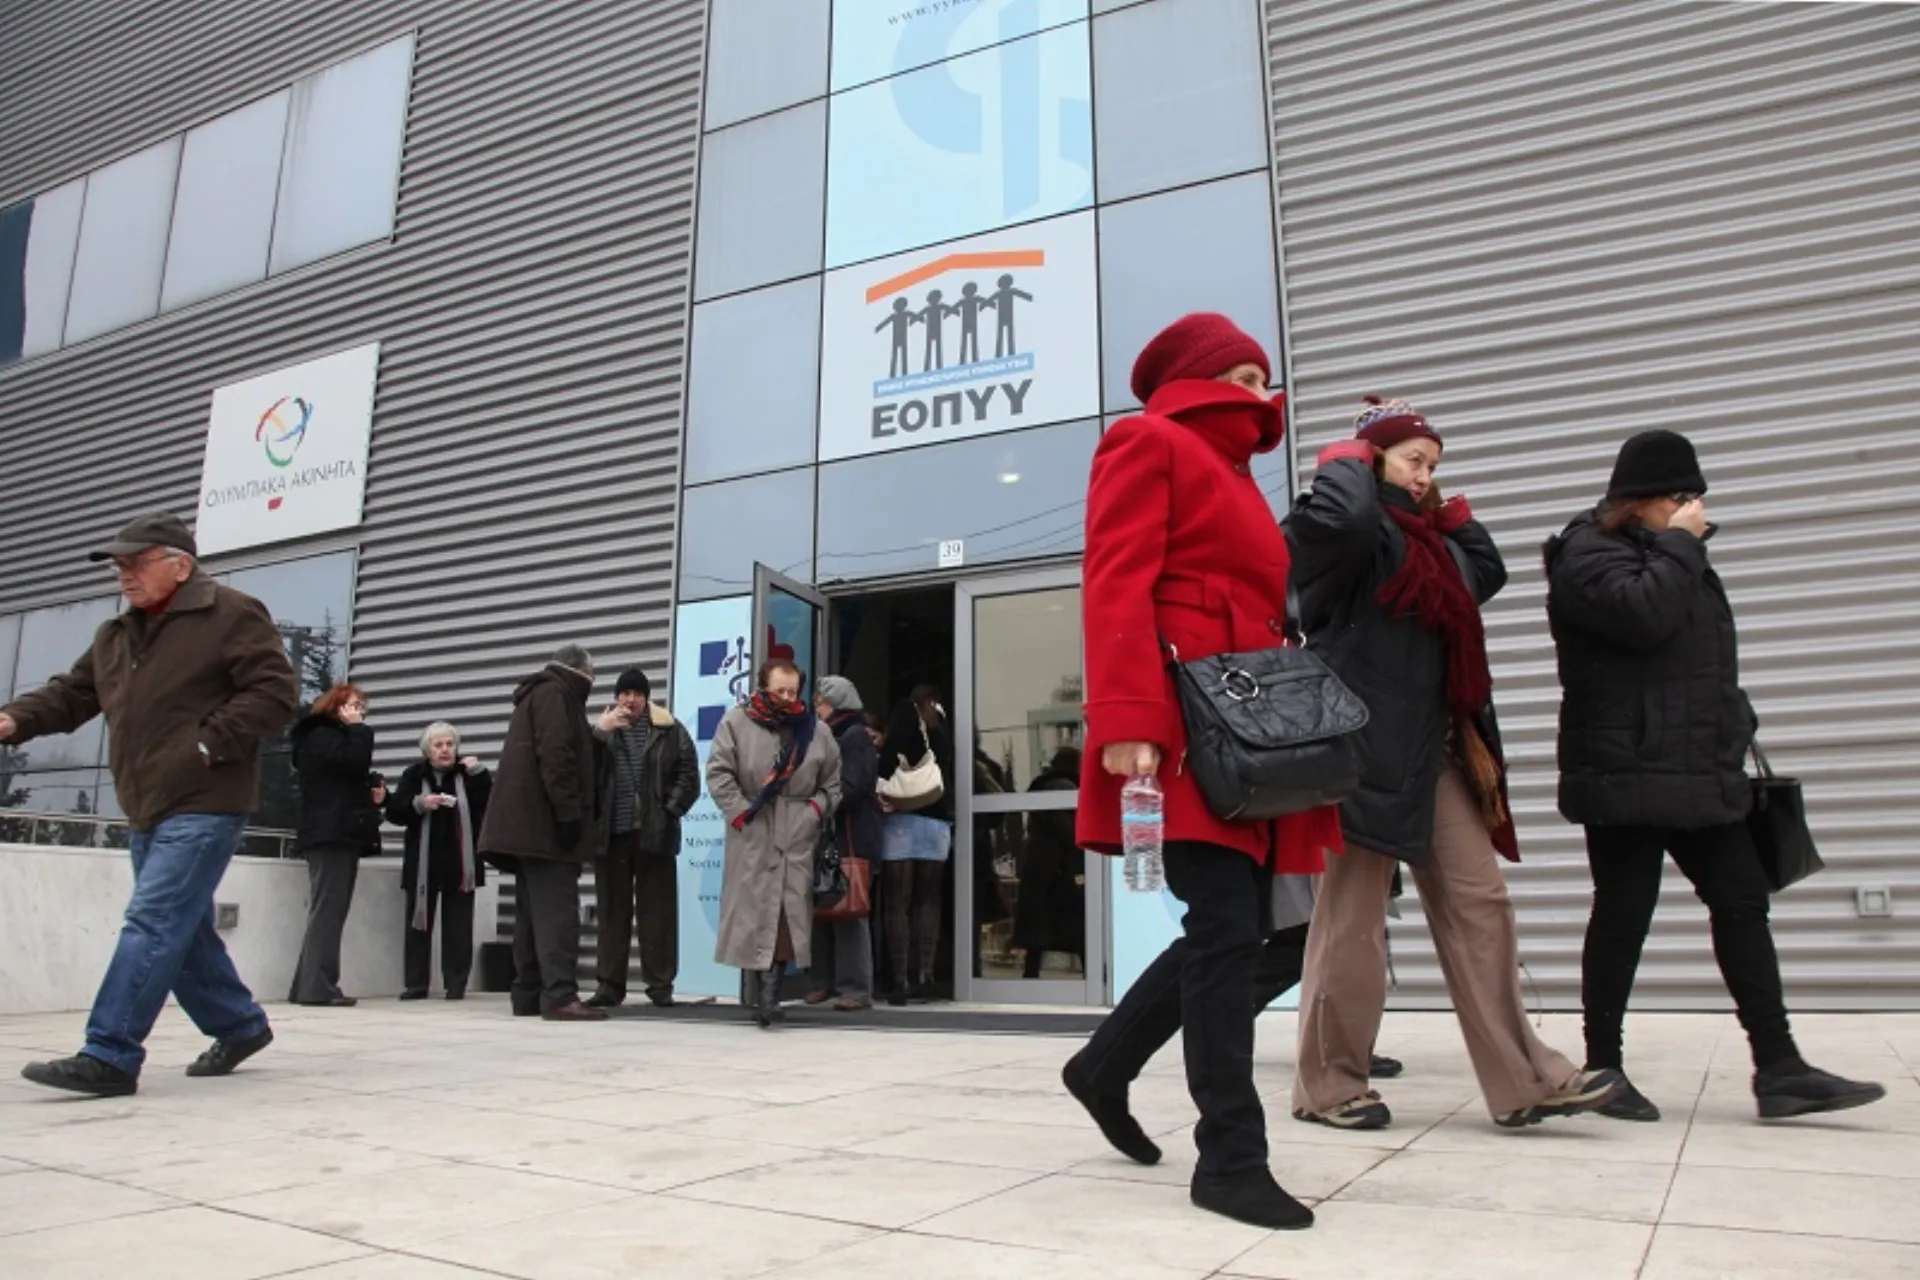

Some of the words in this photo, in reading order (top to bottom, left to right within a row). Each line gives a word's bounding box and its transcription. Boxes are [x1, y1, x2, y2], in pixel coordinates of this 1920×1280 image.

[871, 379, 1033, 439] ΕΟΠΥΥ
[291, 460, 355, 489] ΑΚΙΝΗΤΑ
[942, 542, 961, 558] 39
